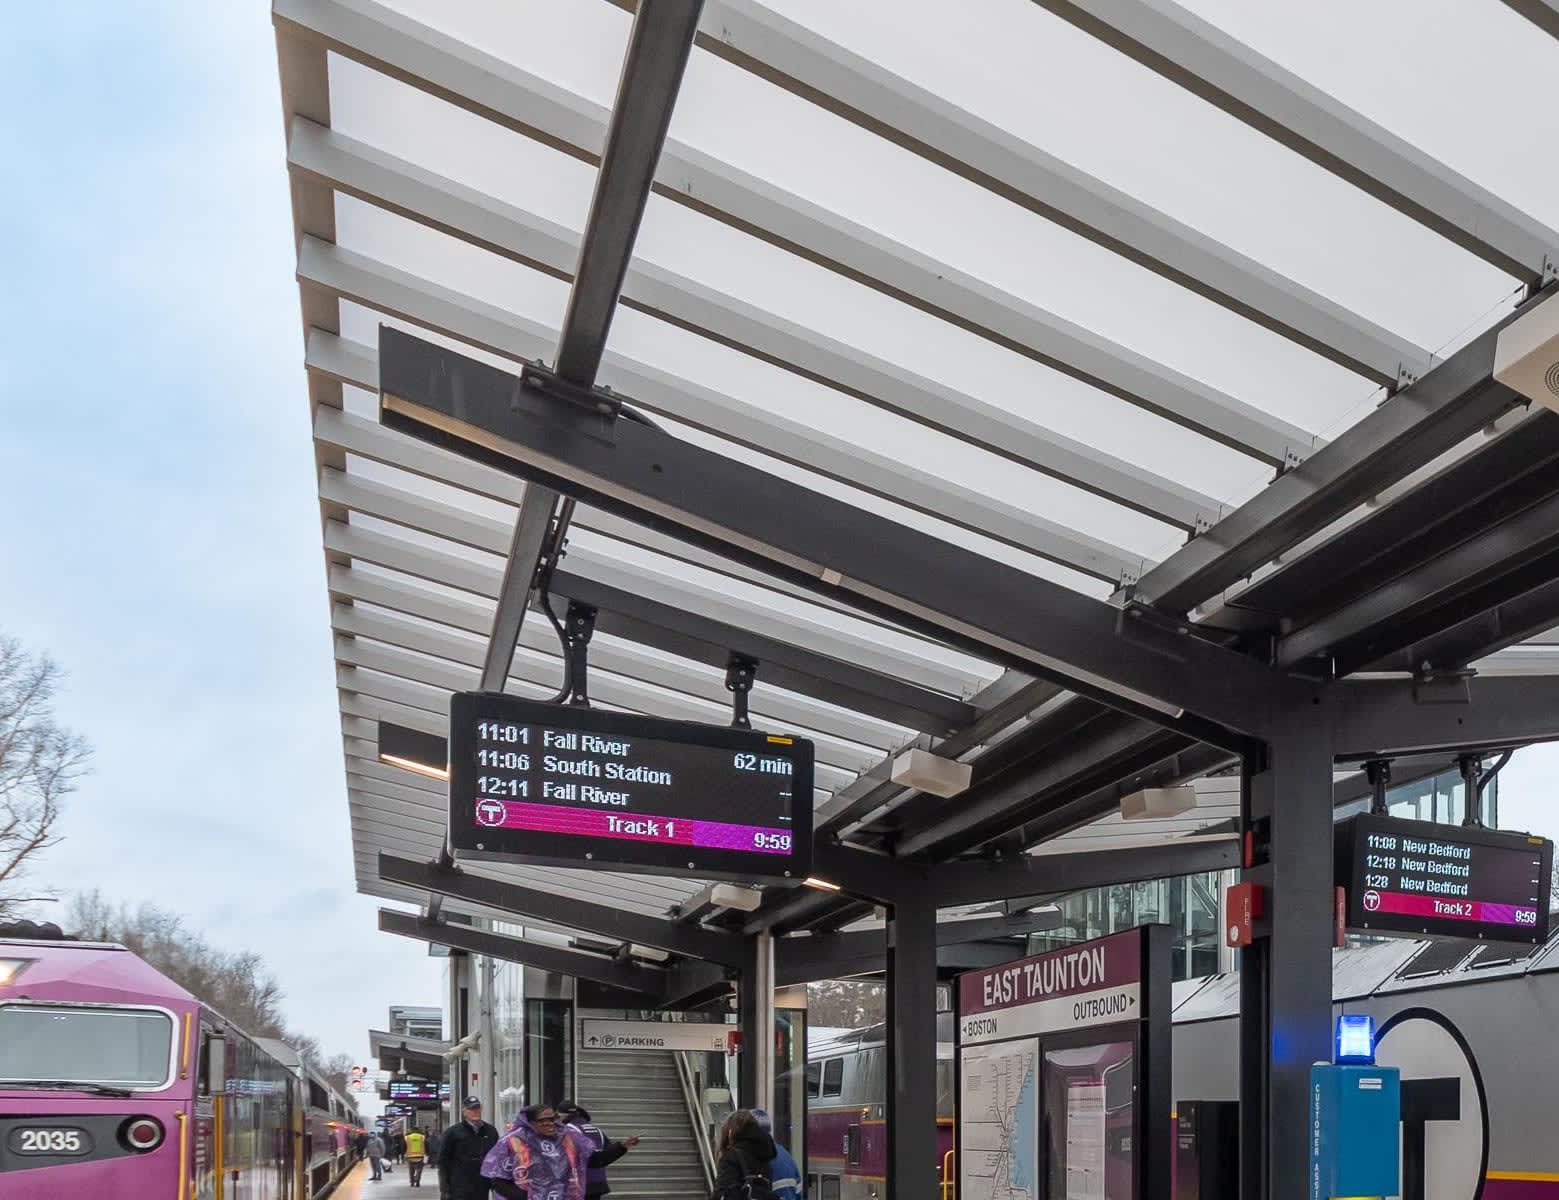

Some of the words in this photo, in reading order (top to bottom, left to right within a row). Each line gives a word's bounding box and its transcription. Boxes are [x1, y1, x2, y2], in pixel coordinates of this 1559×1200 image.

[477, 722, 528, 745] 11:01
[543, 731, 577, 750] Fall
[581, 735, 631, 757] River
[477, 749, 530, 771] 11:06
[543, 756, 600, 777] South
[605, 762, 672, 786] Station
[733, 753, 756, 772] 62
[759, 755, 793, 776] min
[477, 776, 528, 798] 12:11
[543, 782, 577, 802] Fall
[581, 786, 630, 807] River
[606, 816, 659, 838] Track
[665, 822, 675, 839] 1
[754, 832, 792, 850] 9:59
[1367, 835, 1397, 850] 11:08
[1402, 839, 1427, 854] New
[1428, 842, 1471, 860] Bedford
[1366, 855, 1397, 870] 12:18
[1401, 857, 1426, 872] New
[1427, 861, 1470, 878] Bedford
[1365, 874, 1389, 888] 1:28
[1400, 876, 1425, 891] New
[1426, 879, 1468, 895] Bedford
[1433, 900, 1463, 915] Track
[1464, 903, 1472, 916] 2
[1515, 910, 1537, 924] 9:59
[983, 966, 1021, 1007] EAST
[1024, 946, 1106, 997] TAUNTON
[1073, 993, 1127, 1022] OUTBOUND
[967, 1017, 998, 1037] BOSTON
[617, 1037, 665, 1047] PARKING
[20, 1130, 81, 1151] 2035
